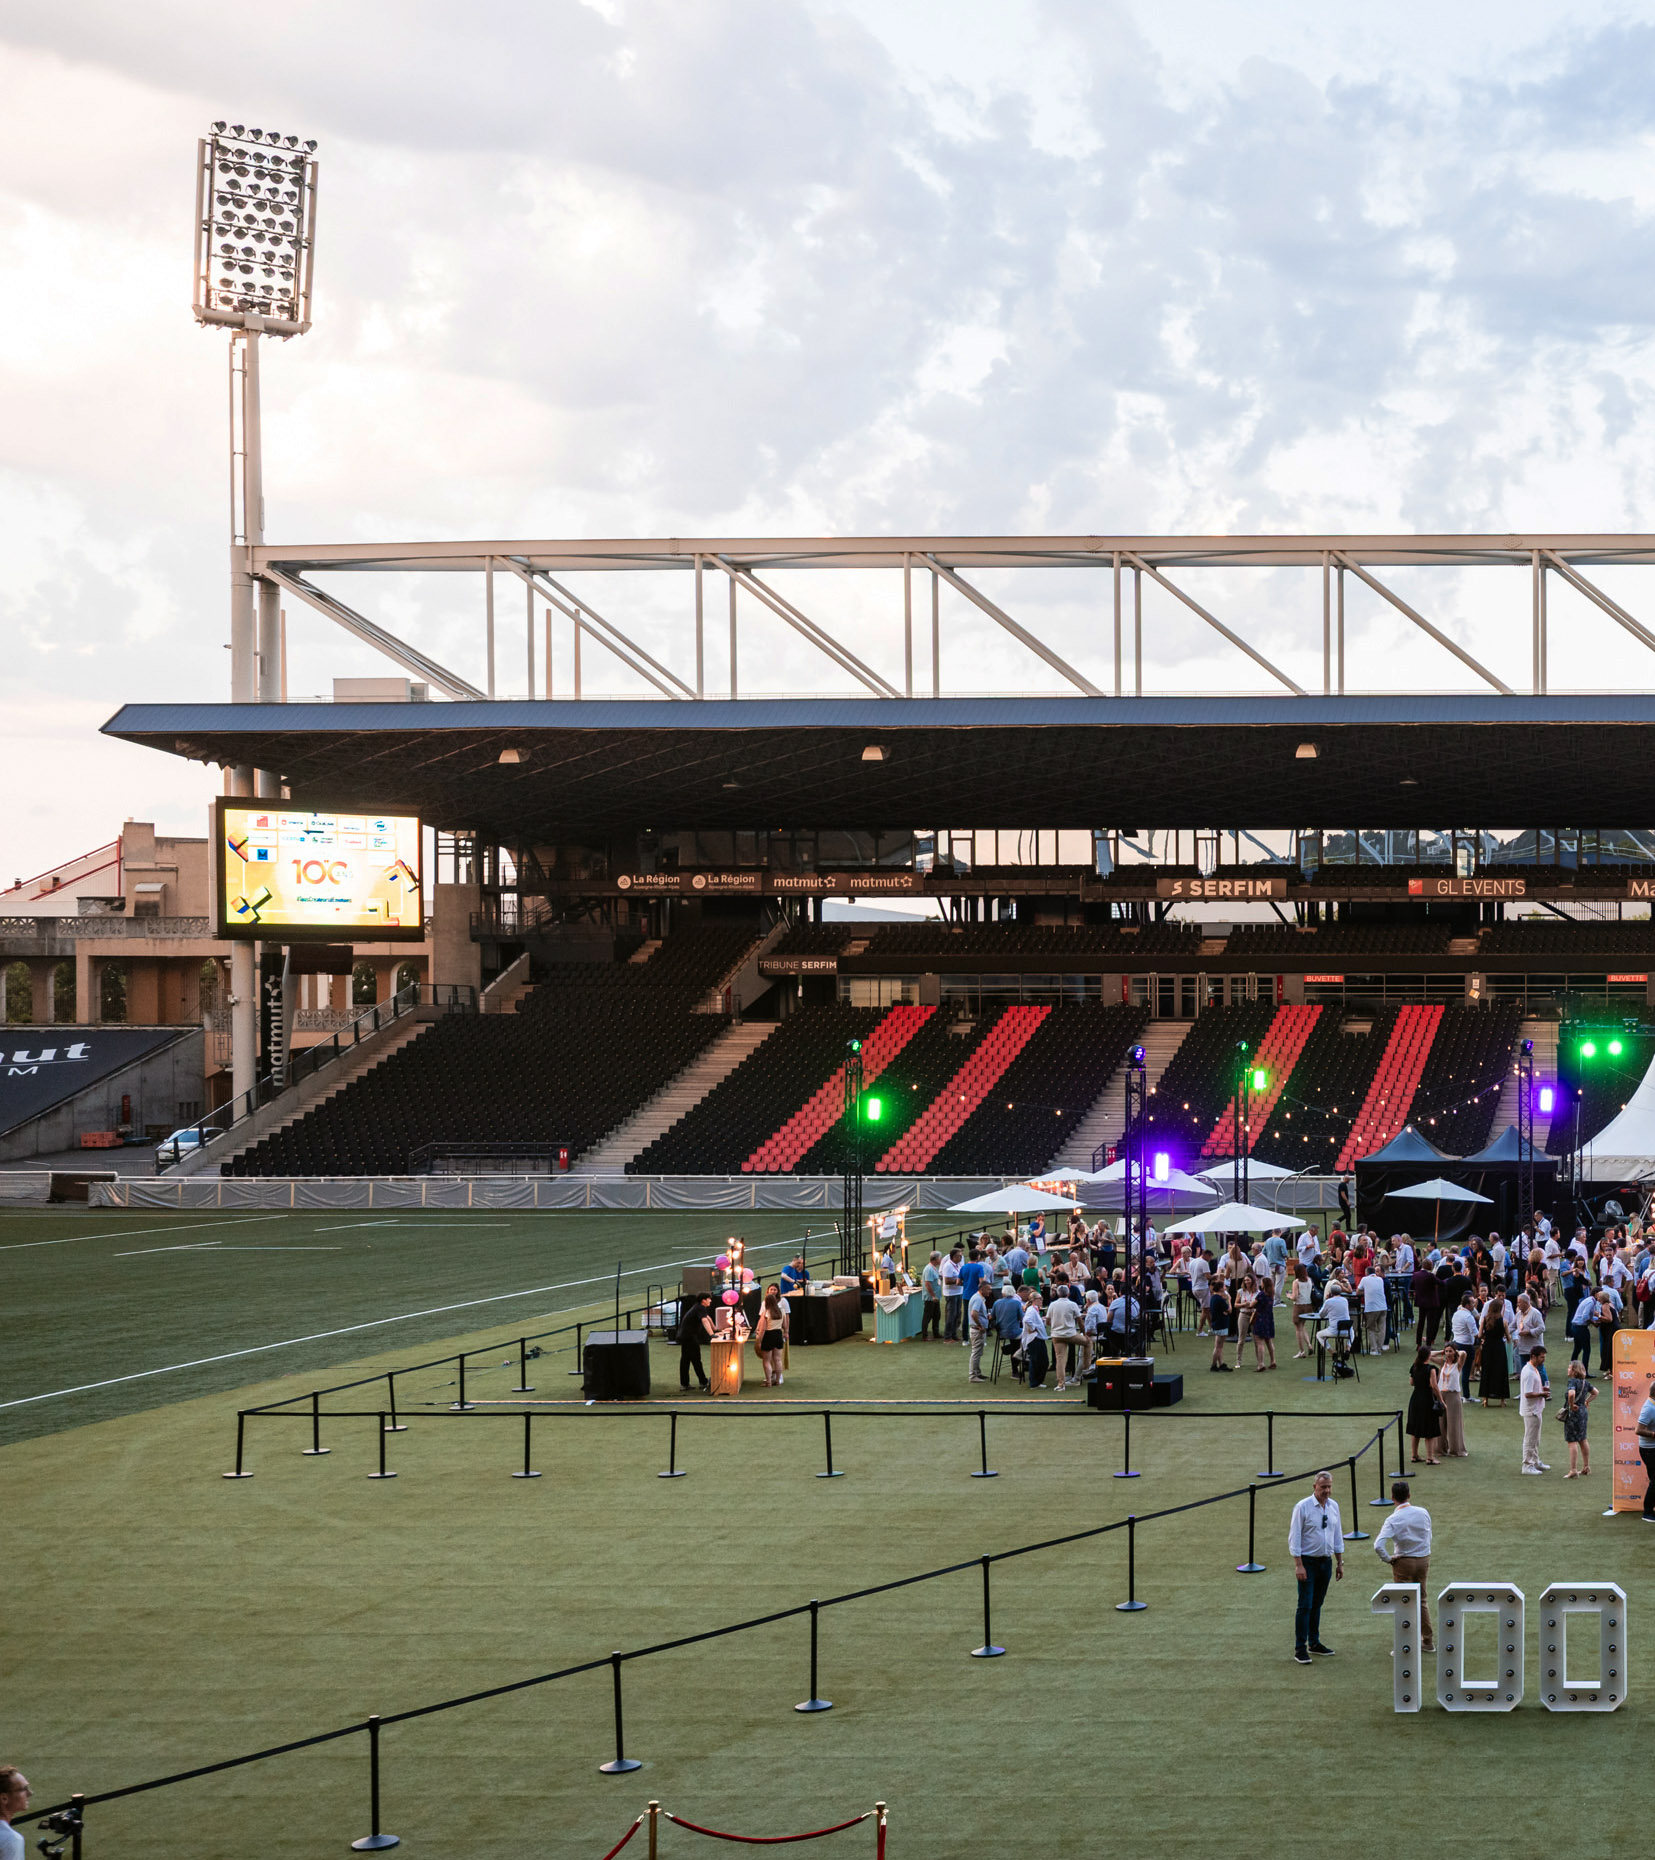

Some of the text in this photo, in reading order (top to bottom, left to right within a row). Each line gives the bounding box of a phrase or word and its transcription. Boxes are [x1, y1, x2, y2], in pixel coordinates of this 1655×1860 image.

[633, 874, 680, 886] La Région
[708, 874, 755, 885] La Région
[773, 877, 824, 888] matmut
[850, 877, 899, 888] matmut
[1189, 880, 1273, 897] SERFIM
[1437, 880, 1526, 896] GL EVENTS
[759, 960, 838, 970] TRIBUNE SERFIM
[267, 998, 284, 1087] matmut
[0, 1042, 91, 1064] ut
[1371, 1581, 1627, 1714] 100
